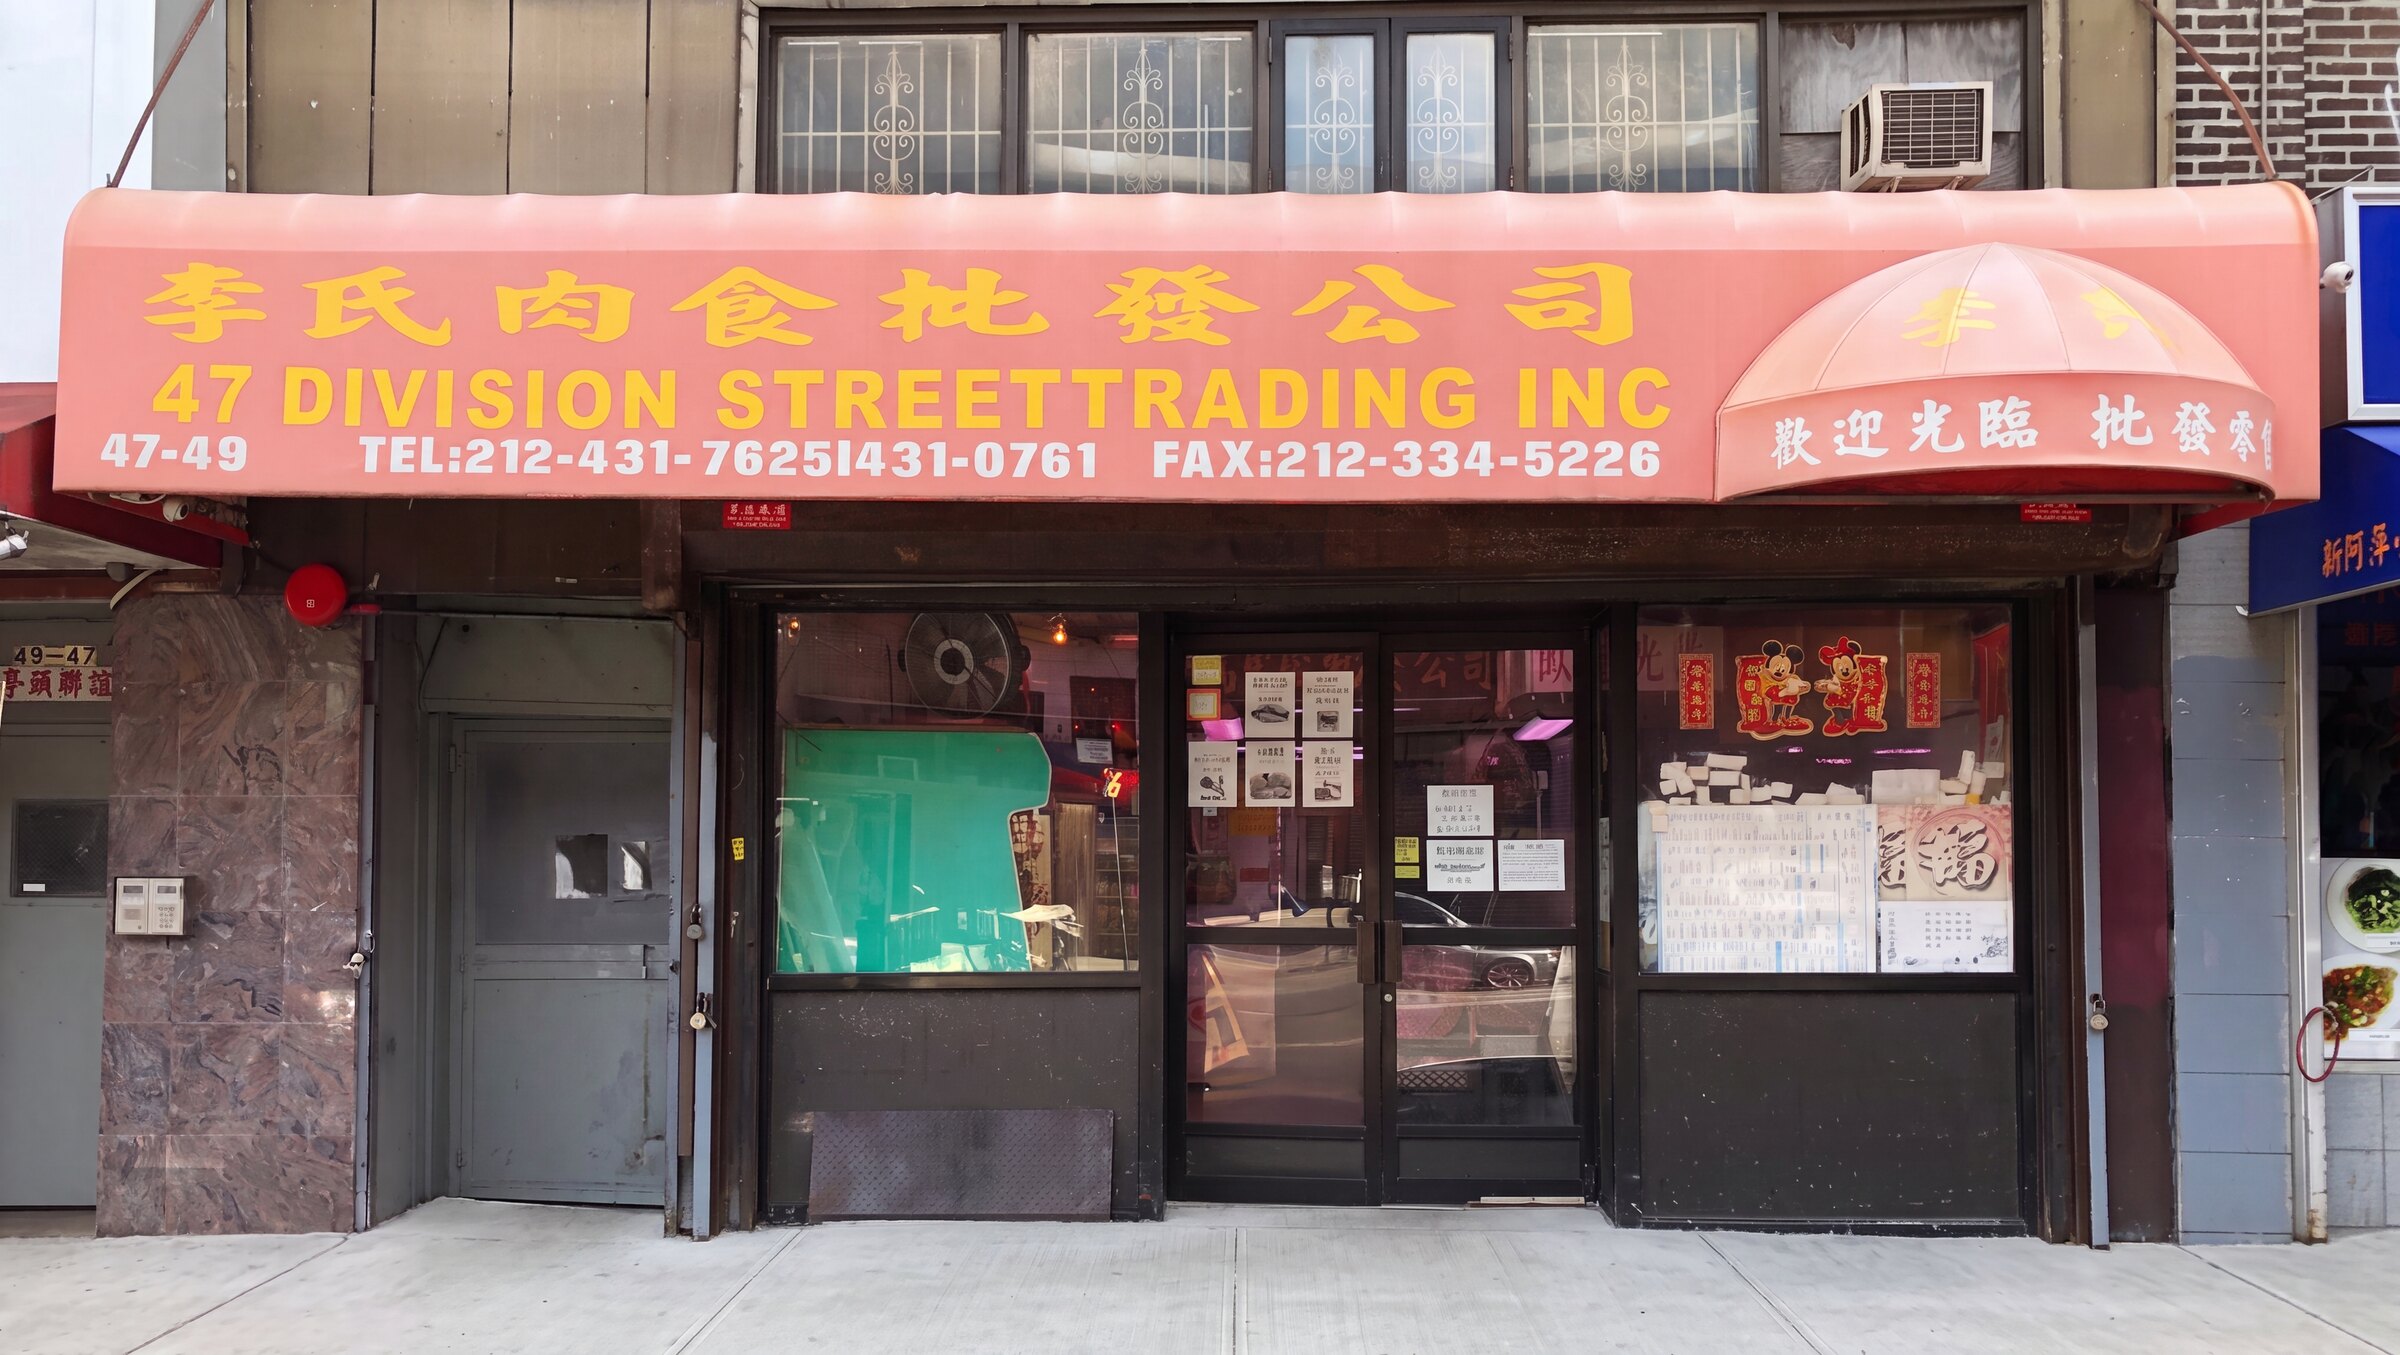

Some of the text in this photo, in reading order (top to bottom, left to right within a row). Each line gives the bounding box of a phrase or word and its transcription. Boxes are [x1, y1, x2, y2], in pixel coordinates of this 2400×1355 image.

[144, 262, 1634, 347] 李氏肉食批發公司
[152, 364, 253, 424] 47
[283, 367, 676, 430] DIVISION
[1518, 367, 1670, 430] INC
[100, 434, 247, 472] 47-49
[1153, 440, 1660, 478] FAX:212-334-5226
[1771, 396, 2039, 470] 歡迎光臨
